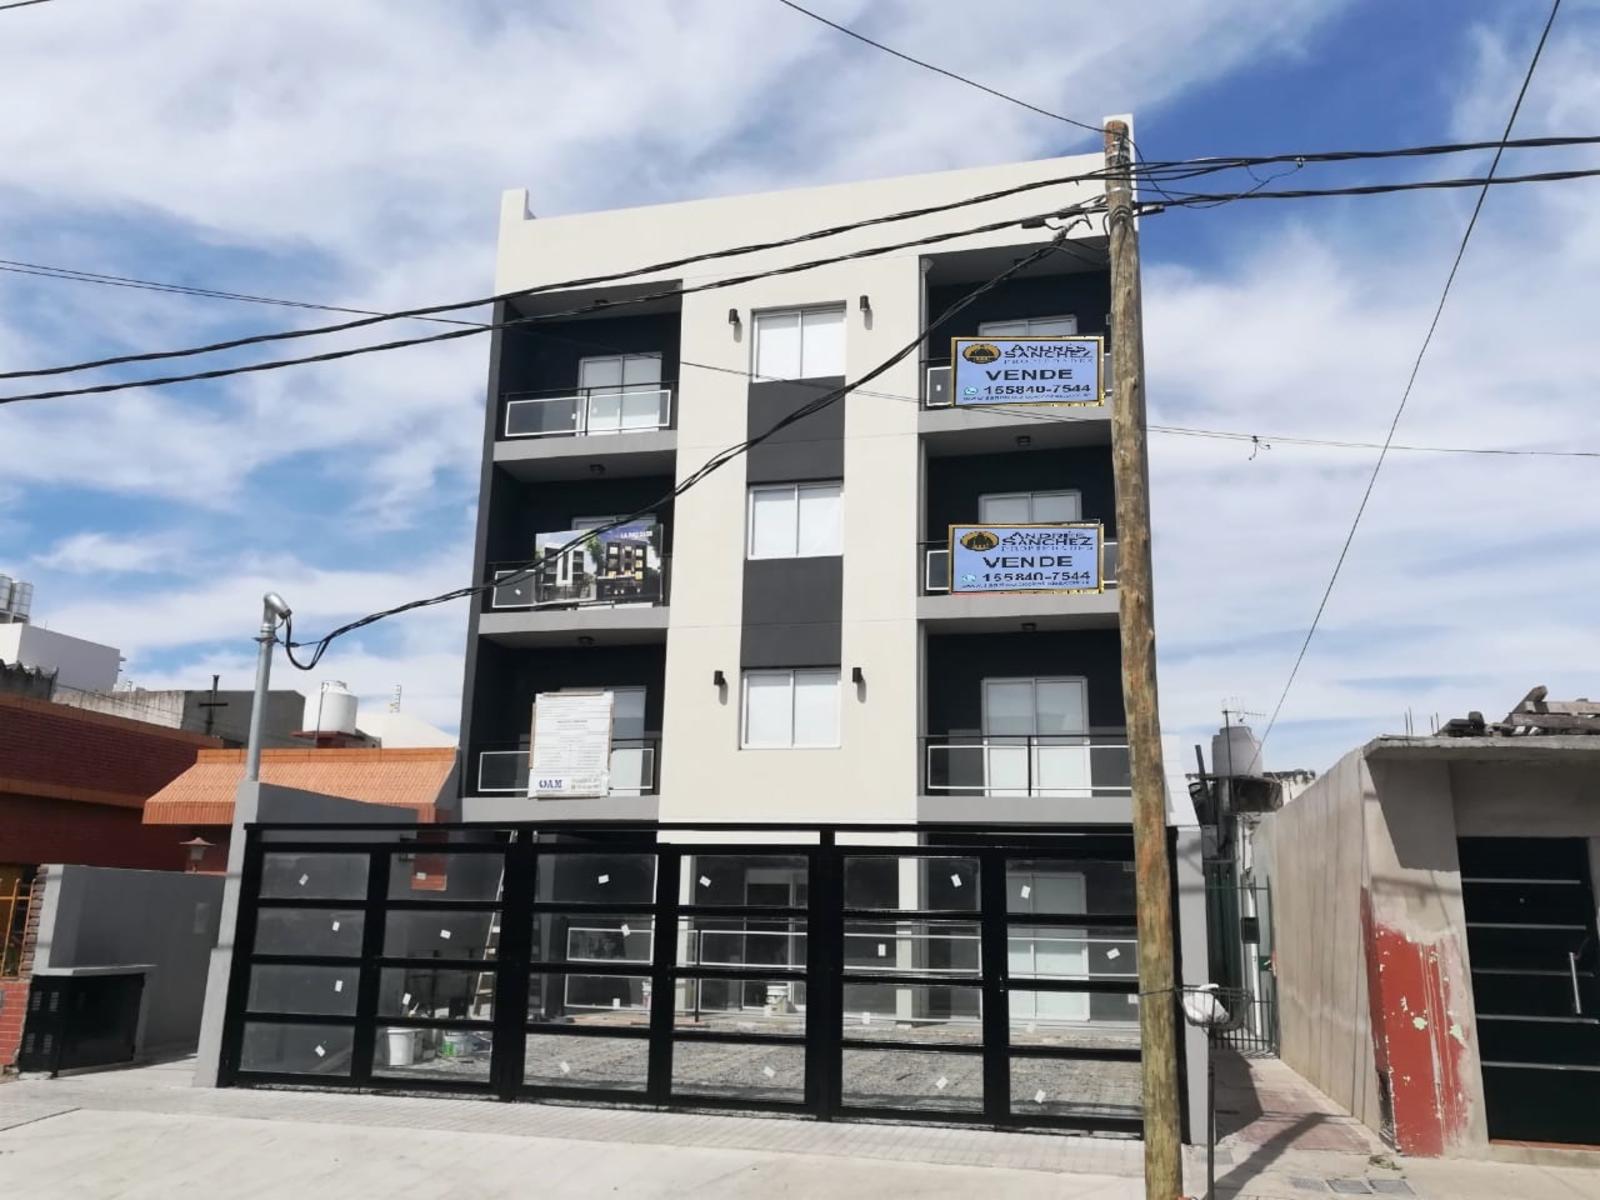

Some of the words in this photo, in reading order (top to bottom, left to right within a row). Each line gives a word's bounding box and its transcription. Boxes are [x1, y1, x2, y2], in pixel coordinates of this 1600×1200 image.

[985, 369, 1073, 381] VENDE
[984, 384, 1091, 395] 155840-7544
[983, 556, 1073, 569] VENDE
[983, 571, 1091, 582] 155840-7544
